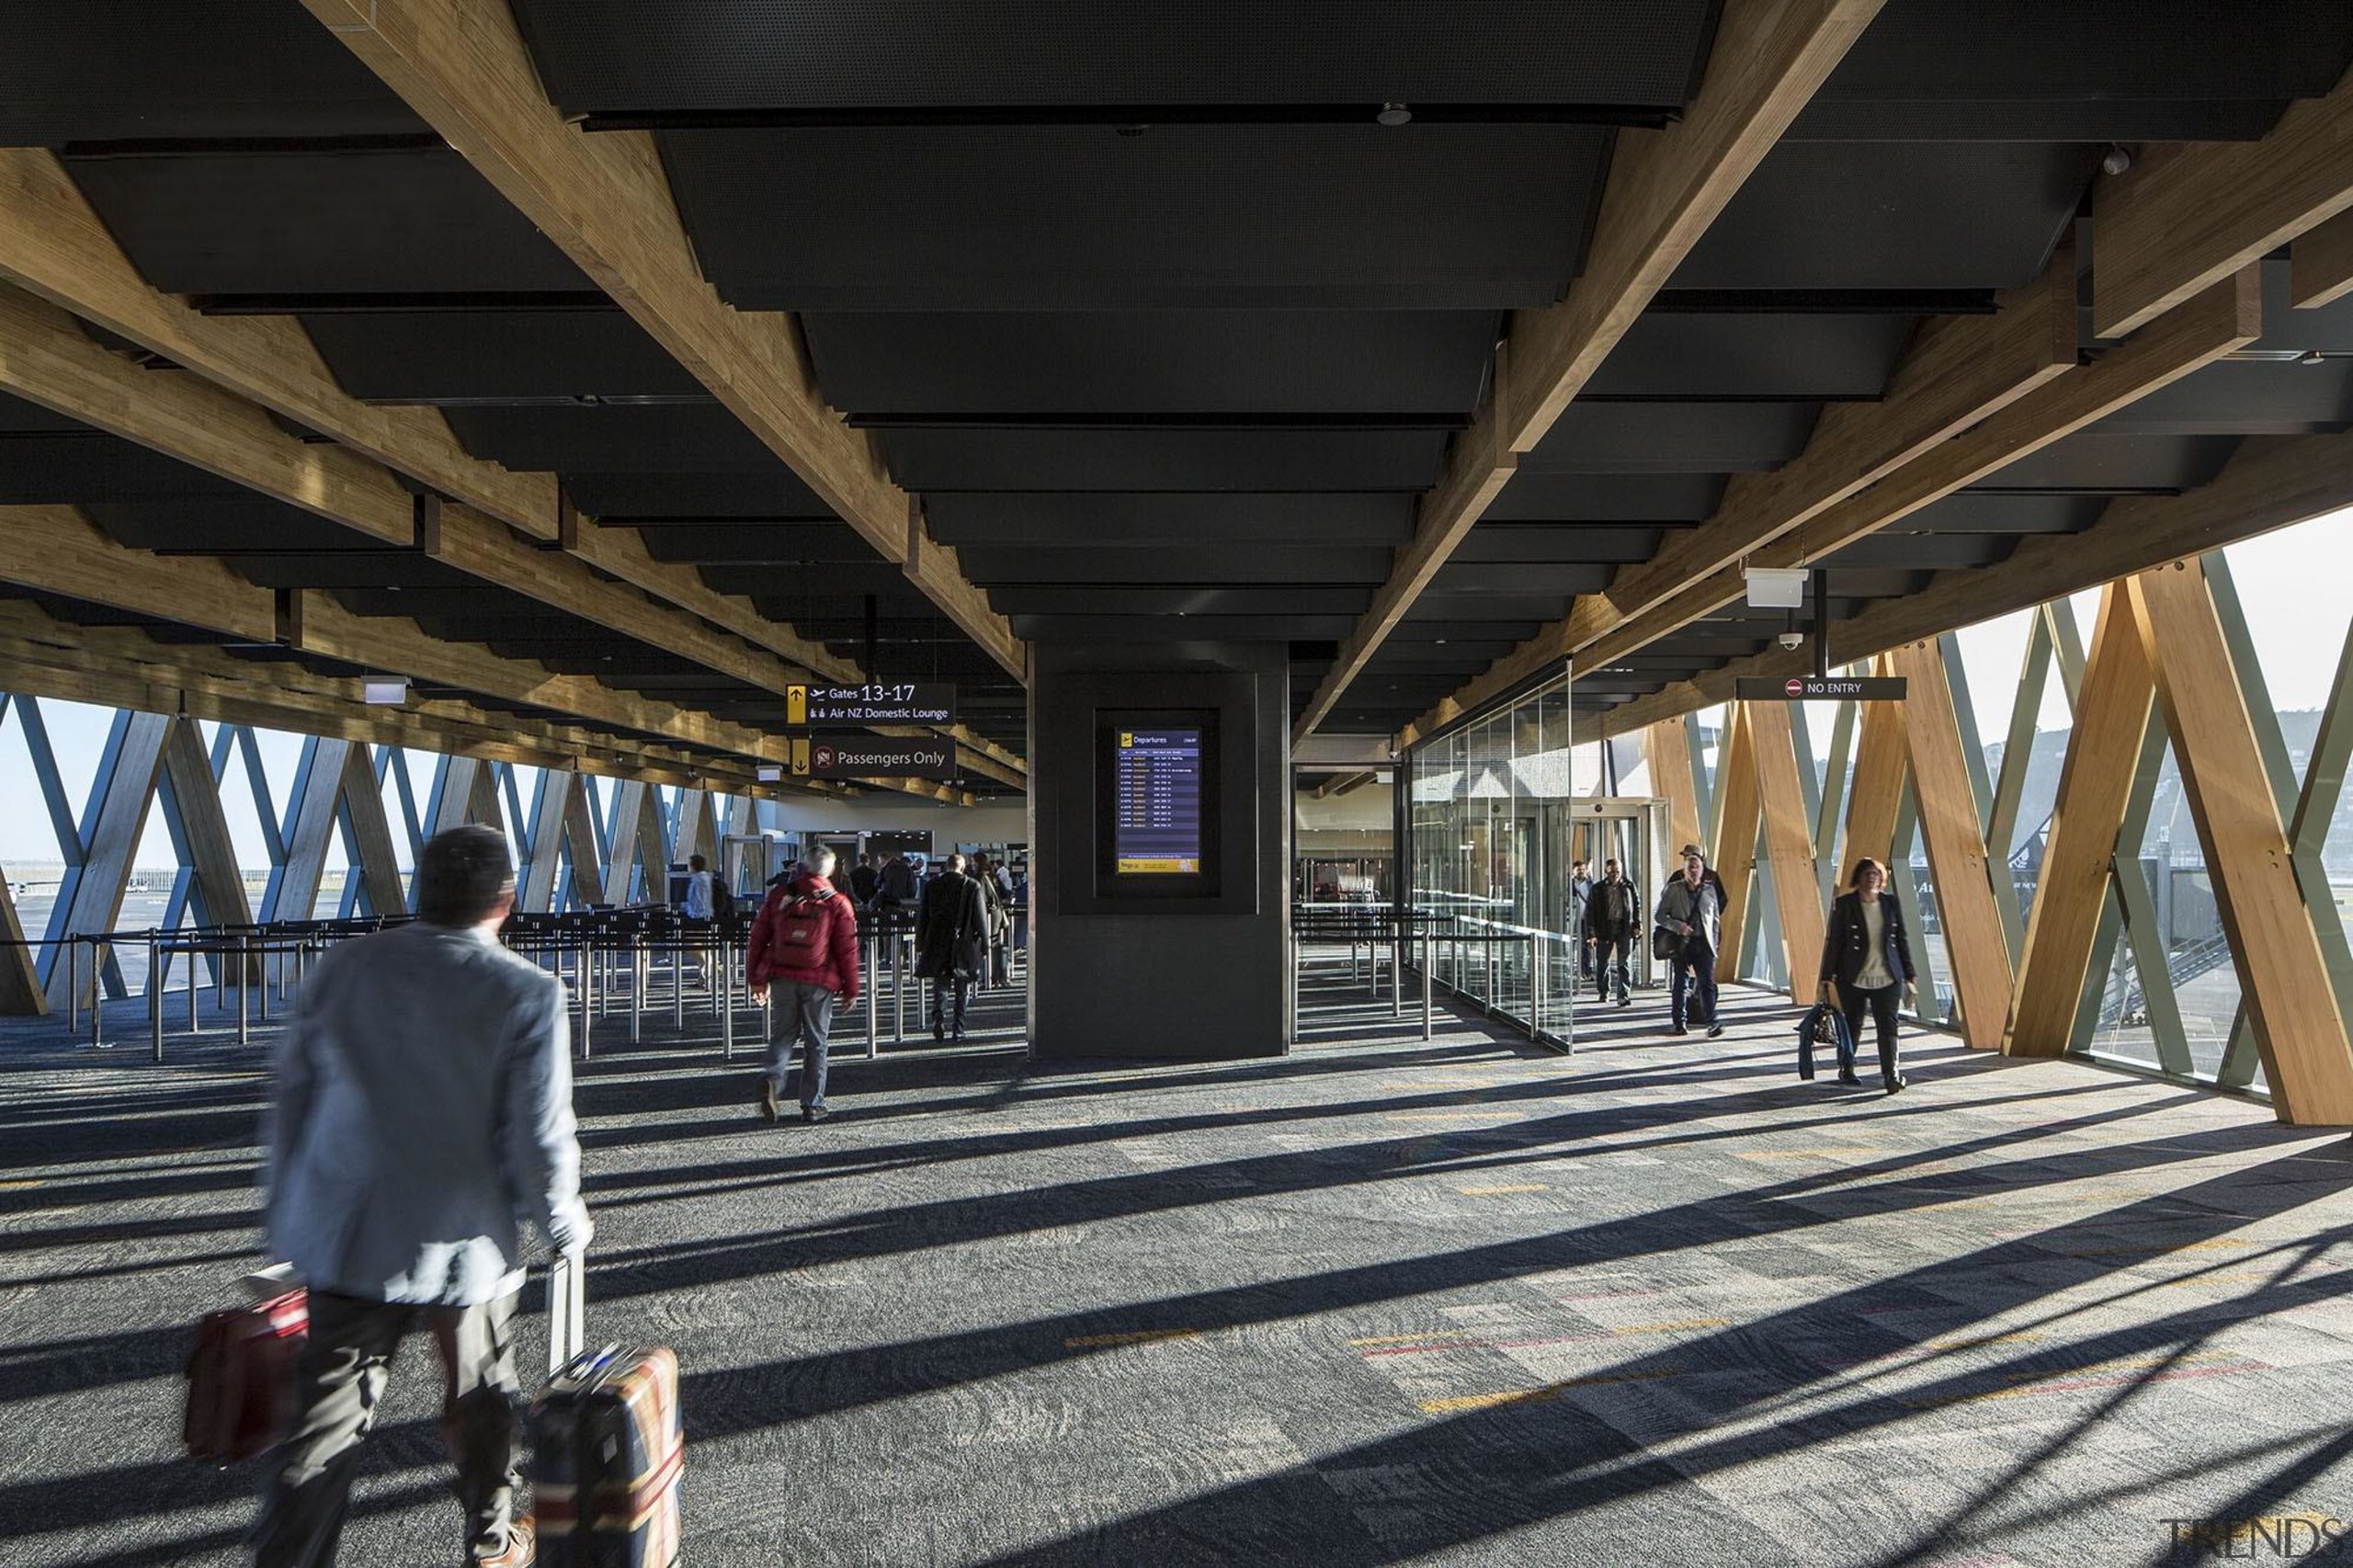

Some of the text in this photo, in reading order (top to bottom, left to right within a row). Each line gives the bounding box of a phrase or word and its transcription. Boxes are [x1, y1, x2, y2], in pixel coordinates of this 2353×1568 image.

[829, 685, 915, 701] Gates 13-17
[1807, 683, 1862, 693] NO ENTRY
[830, 708, 949, 721] Air NZ Domestic Lounge
[1133, 736, 1167, 744] Departures
[838, 752, 945, 767] Passengers Only
